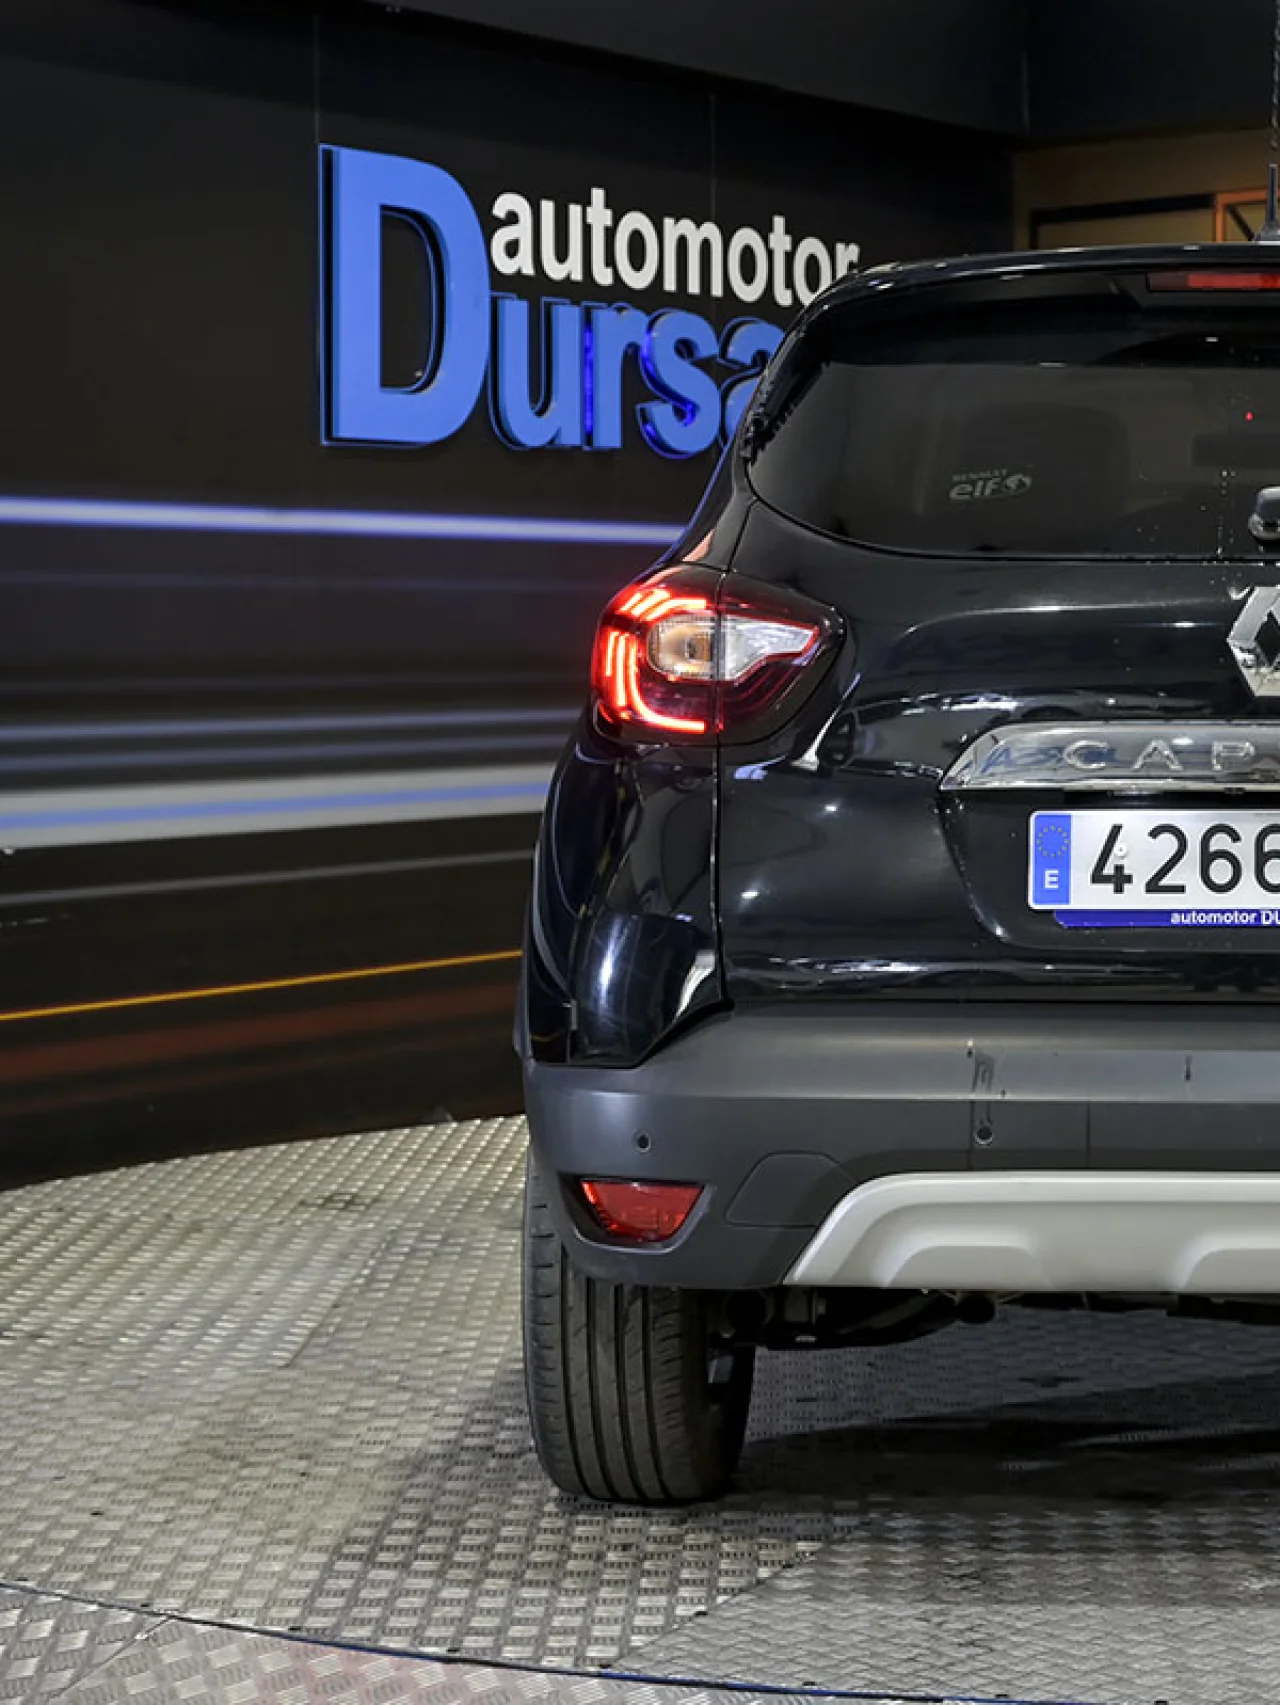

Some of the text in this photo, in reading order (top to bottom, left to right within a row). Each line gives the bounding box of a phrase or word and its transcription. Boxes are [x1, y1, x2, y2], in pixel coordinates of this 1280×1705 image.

[490, 187, 860, 306] automotor
[1044, 869, 1059, 888] E
[1170, 911, 1257, 925] automotor
